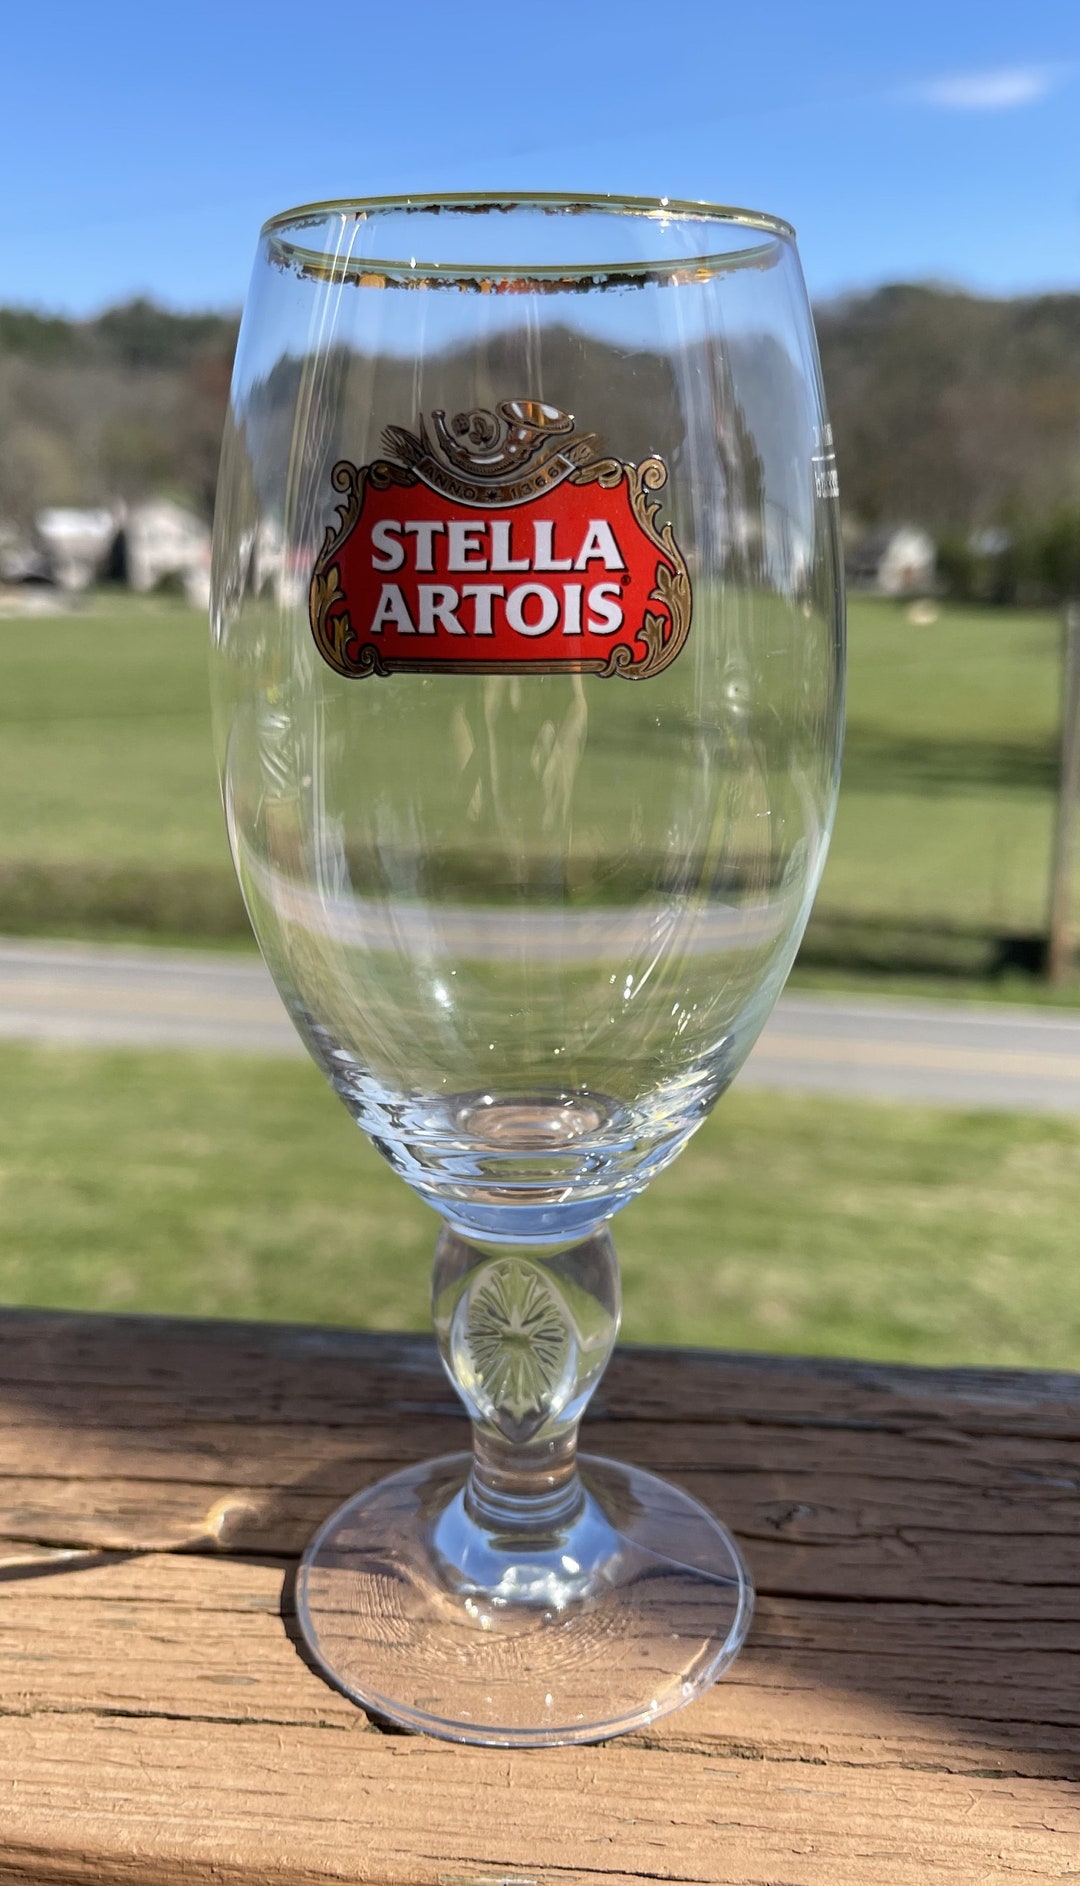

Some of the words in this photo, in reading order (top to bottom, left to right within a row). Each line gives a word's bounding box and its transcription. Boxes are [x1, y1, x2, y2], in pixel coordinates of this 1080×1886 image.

[425, 466, 475, 499] ANNO
[511, 466, 559, 499] 1366
[371, 520, 625, 572] STELLA
[371, 583, 624, 636] ARTOIS
